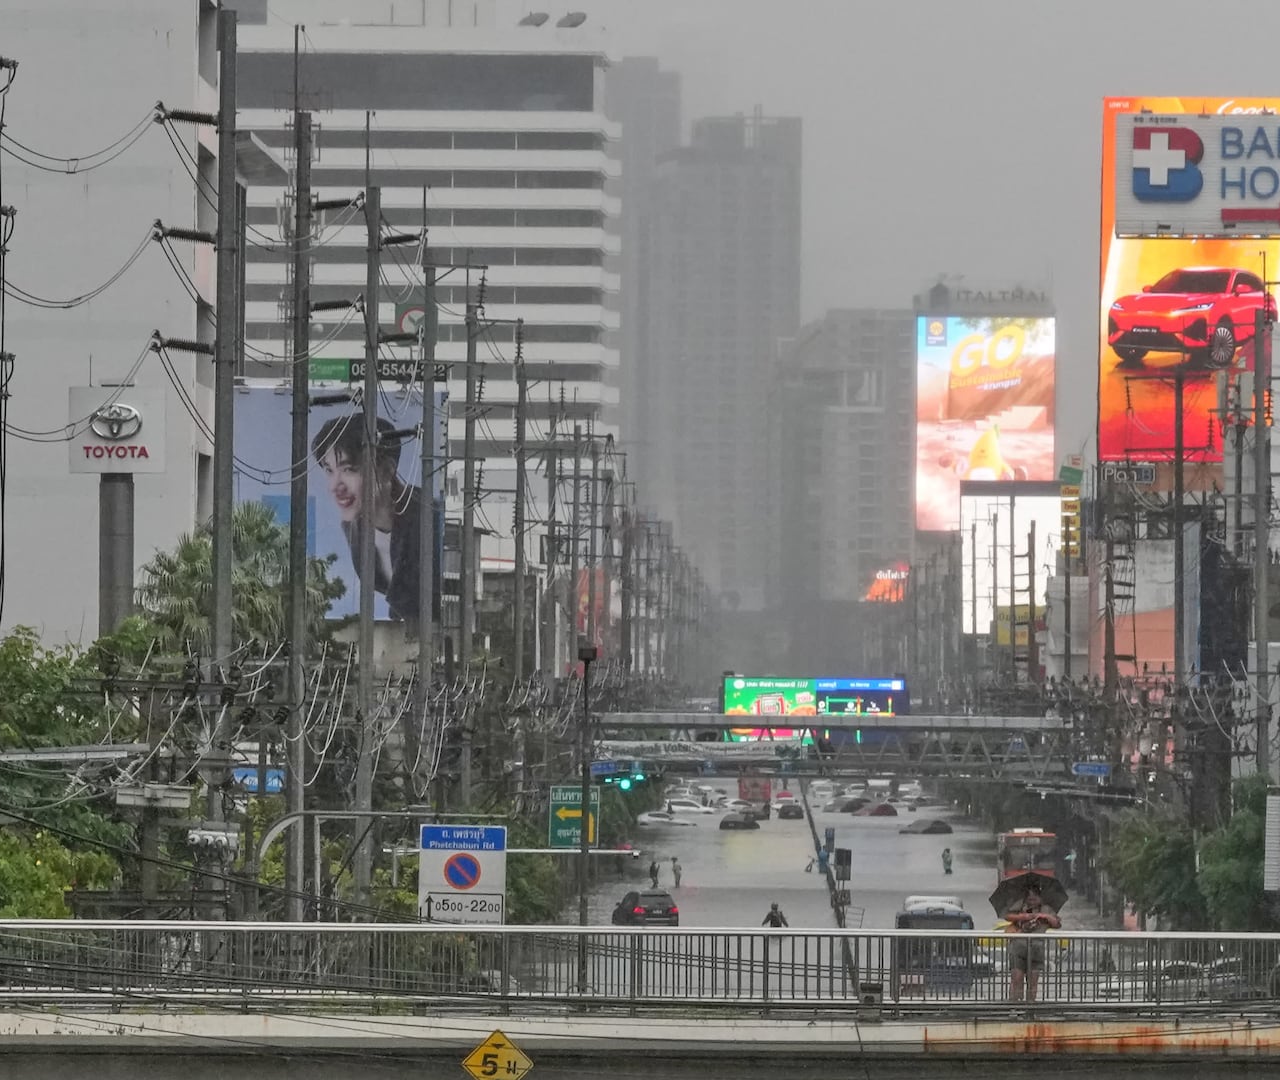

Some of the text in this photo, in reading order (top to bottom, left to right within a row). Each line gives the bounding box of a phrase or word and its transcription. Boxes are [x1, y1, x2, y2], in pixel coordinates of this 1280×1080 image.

[950, 324, 1025, 378] GO
[82, 444, 150, 460] TOYOTA
[481, 1053, 498, 1077] 5
